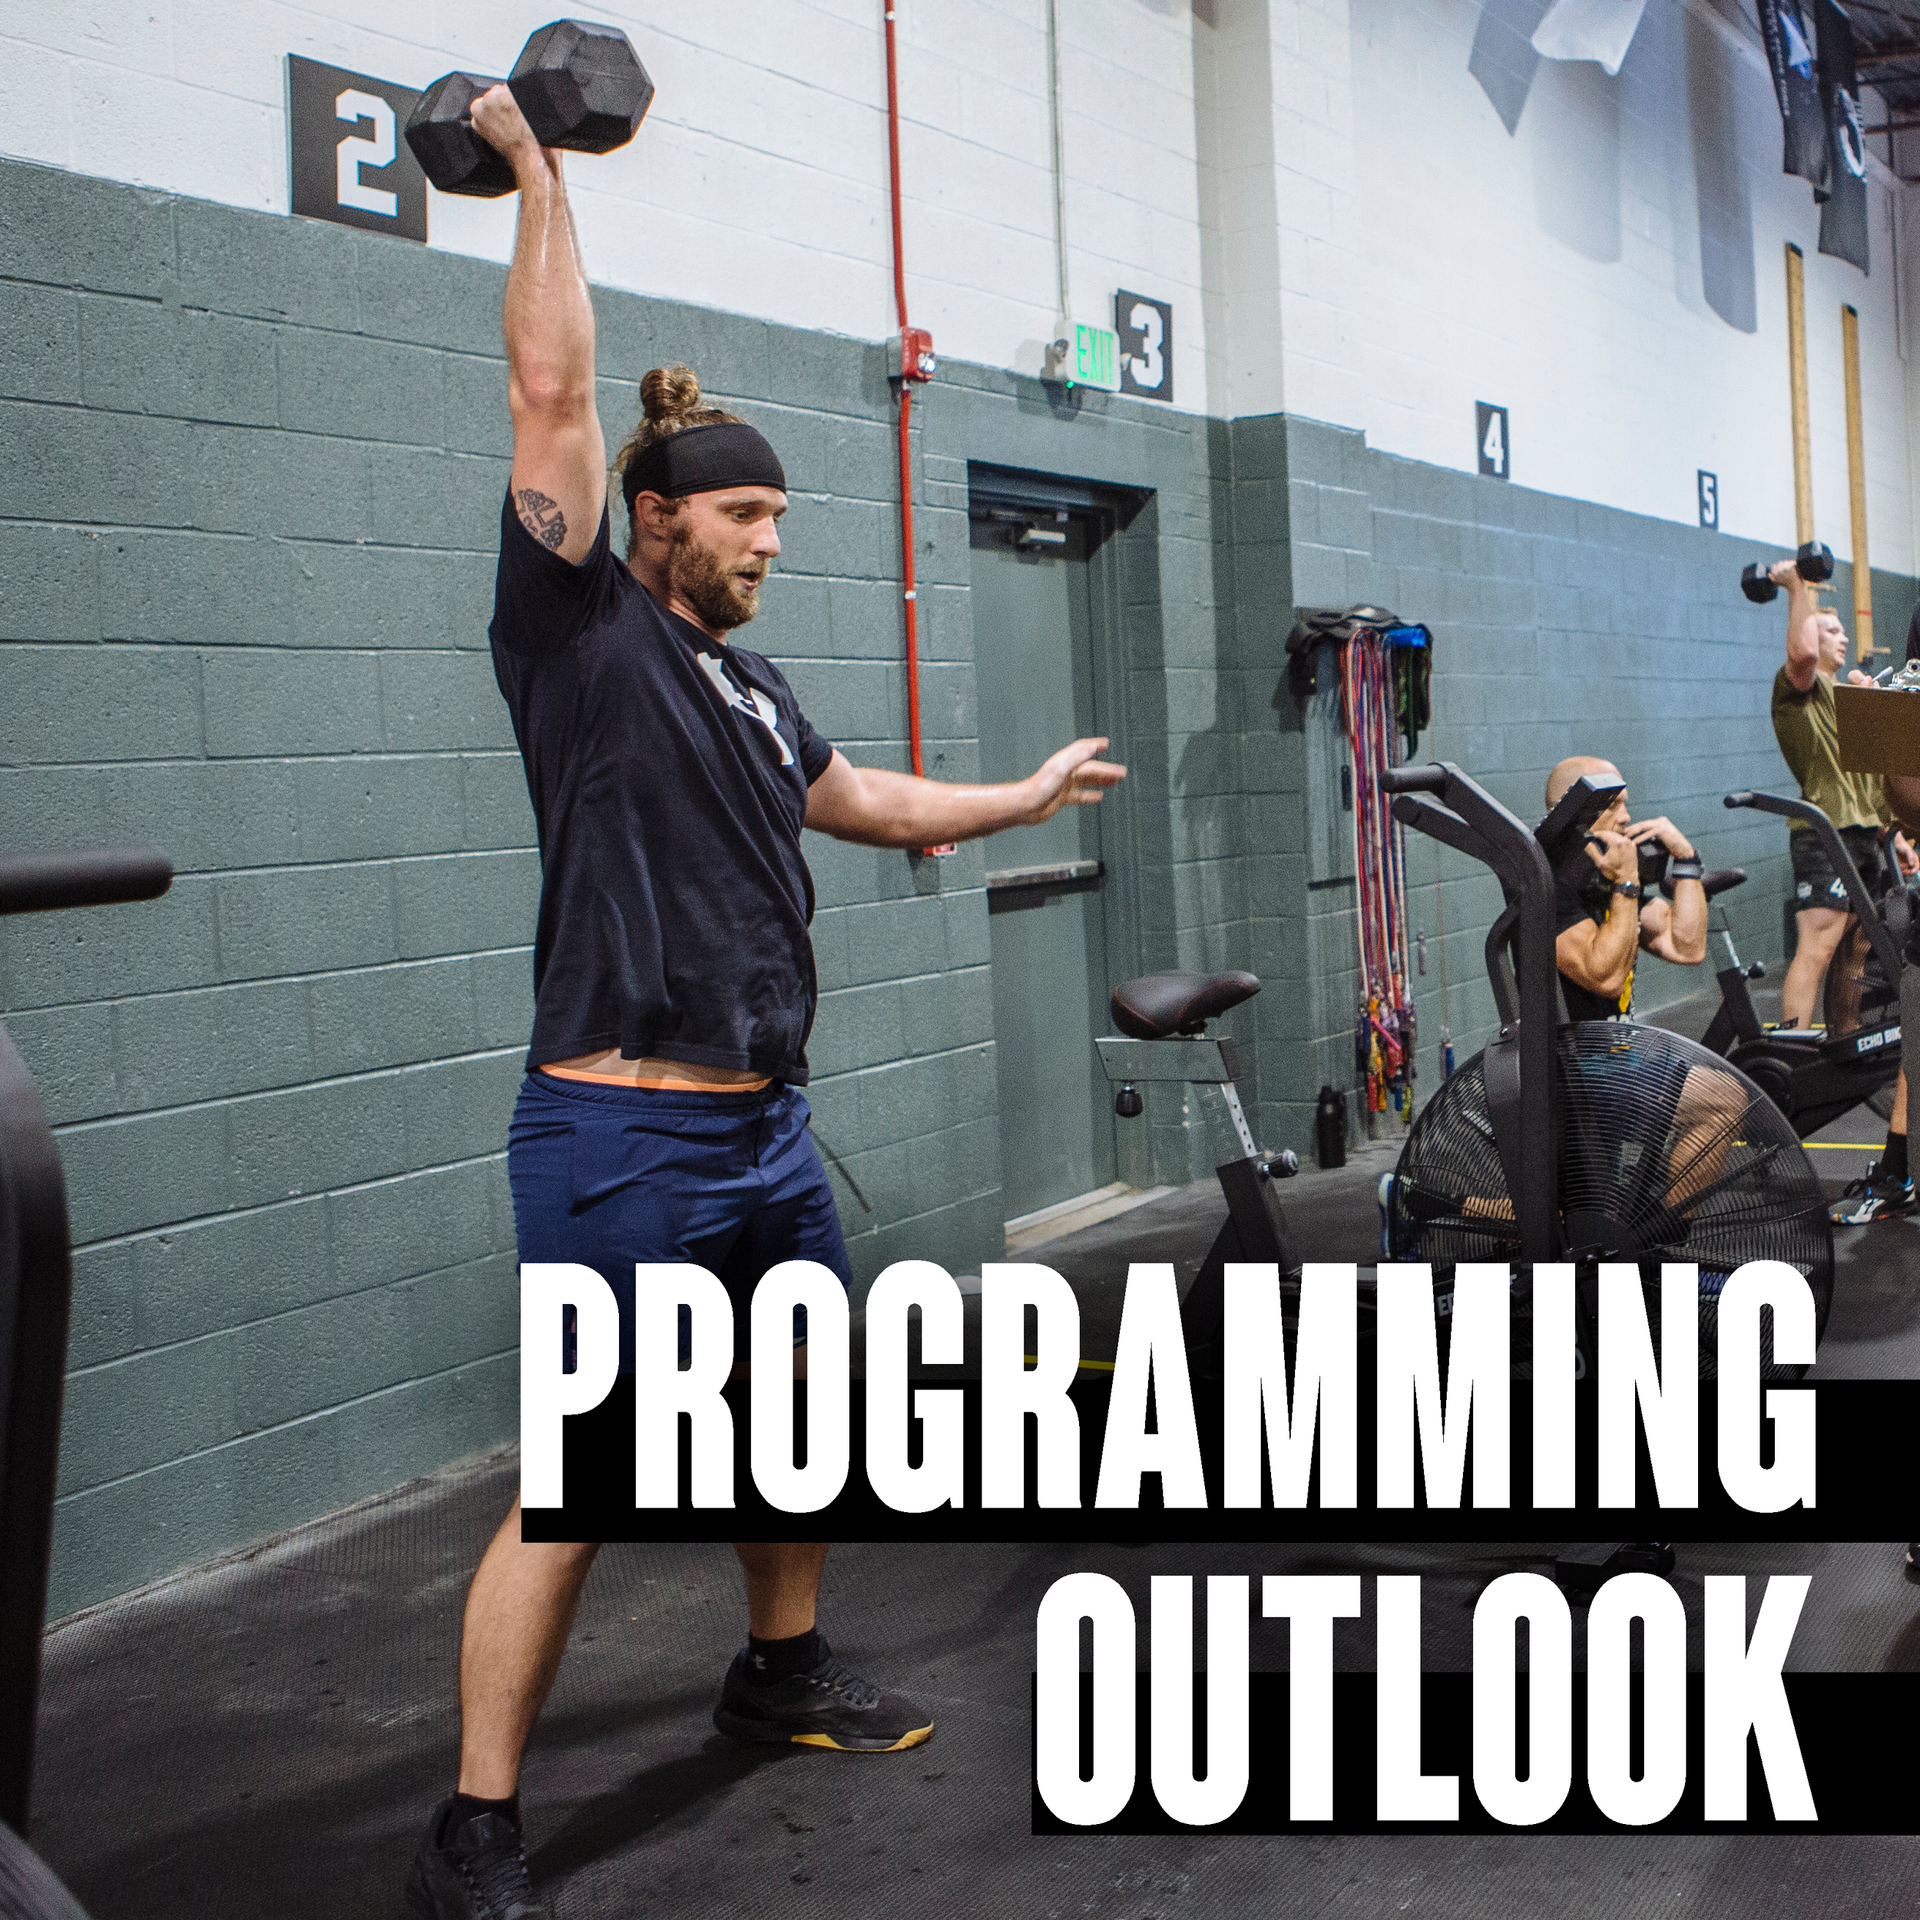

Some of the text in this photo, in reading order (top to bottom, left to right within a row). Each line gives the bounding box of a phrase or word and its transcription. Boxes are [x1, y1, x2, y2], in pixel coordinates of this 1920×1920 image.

[336, 88, 398, 217] 2
[1077, 325, 1113, 385] EXIT
[1130, 304, 1164, 389] 3
[1482, 412, 1504, 475] 4
[1702, 477, 1716, 525] 5
[1829, 877, 1848, 899] 4
[1857, 1026, 1902, 1053] ECHO BIK
